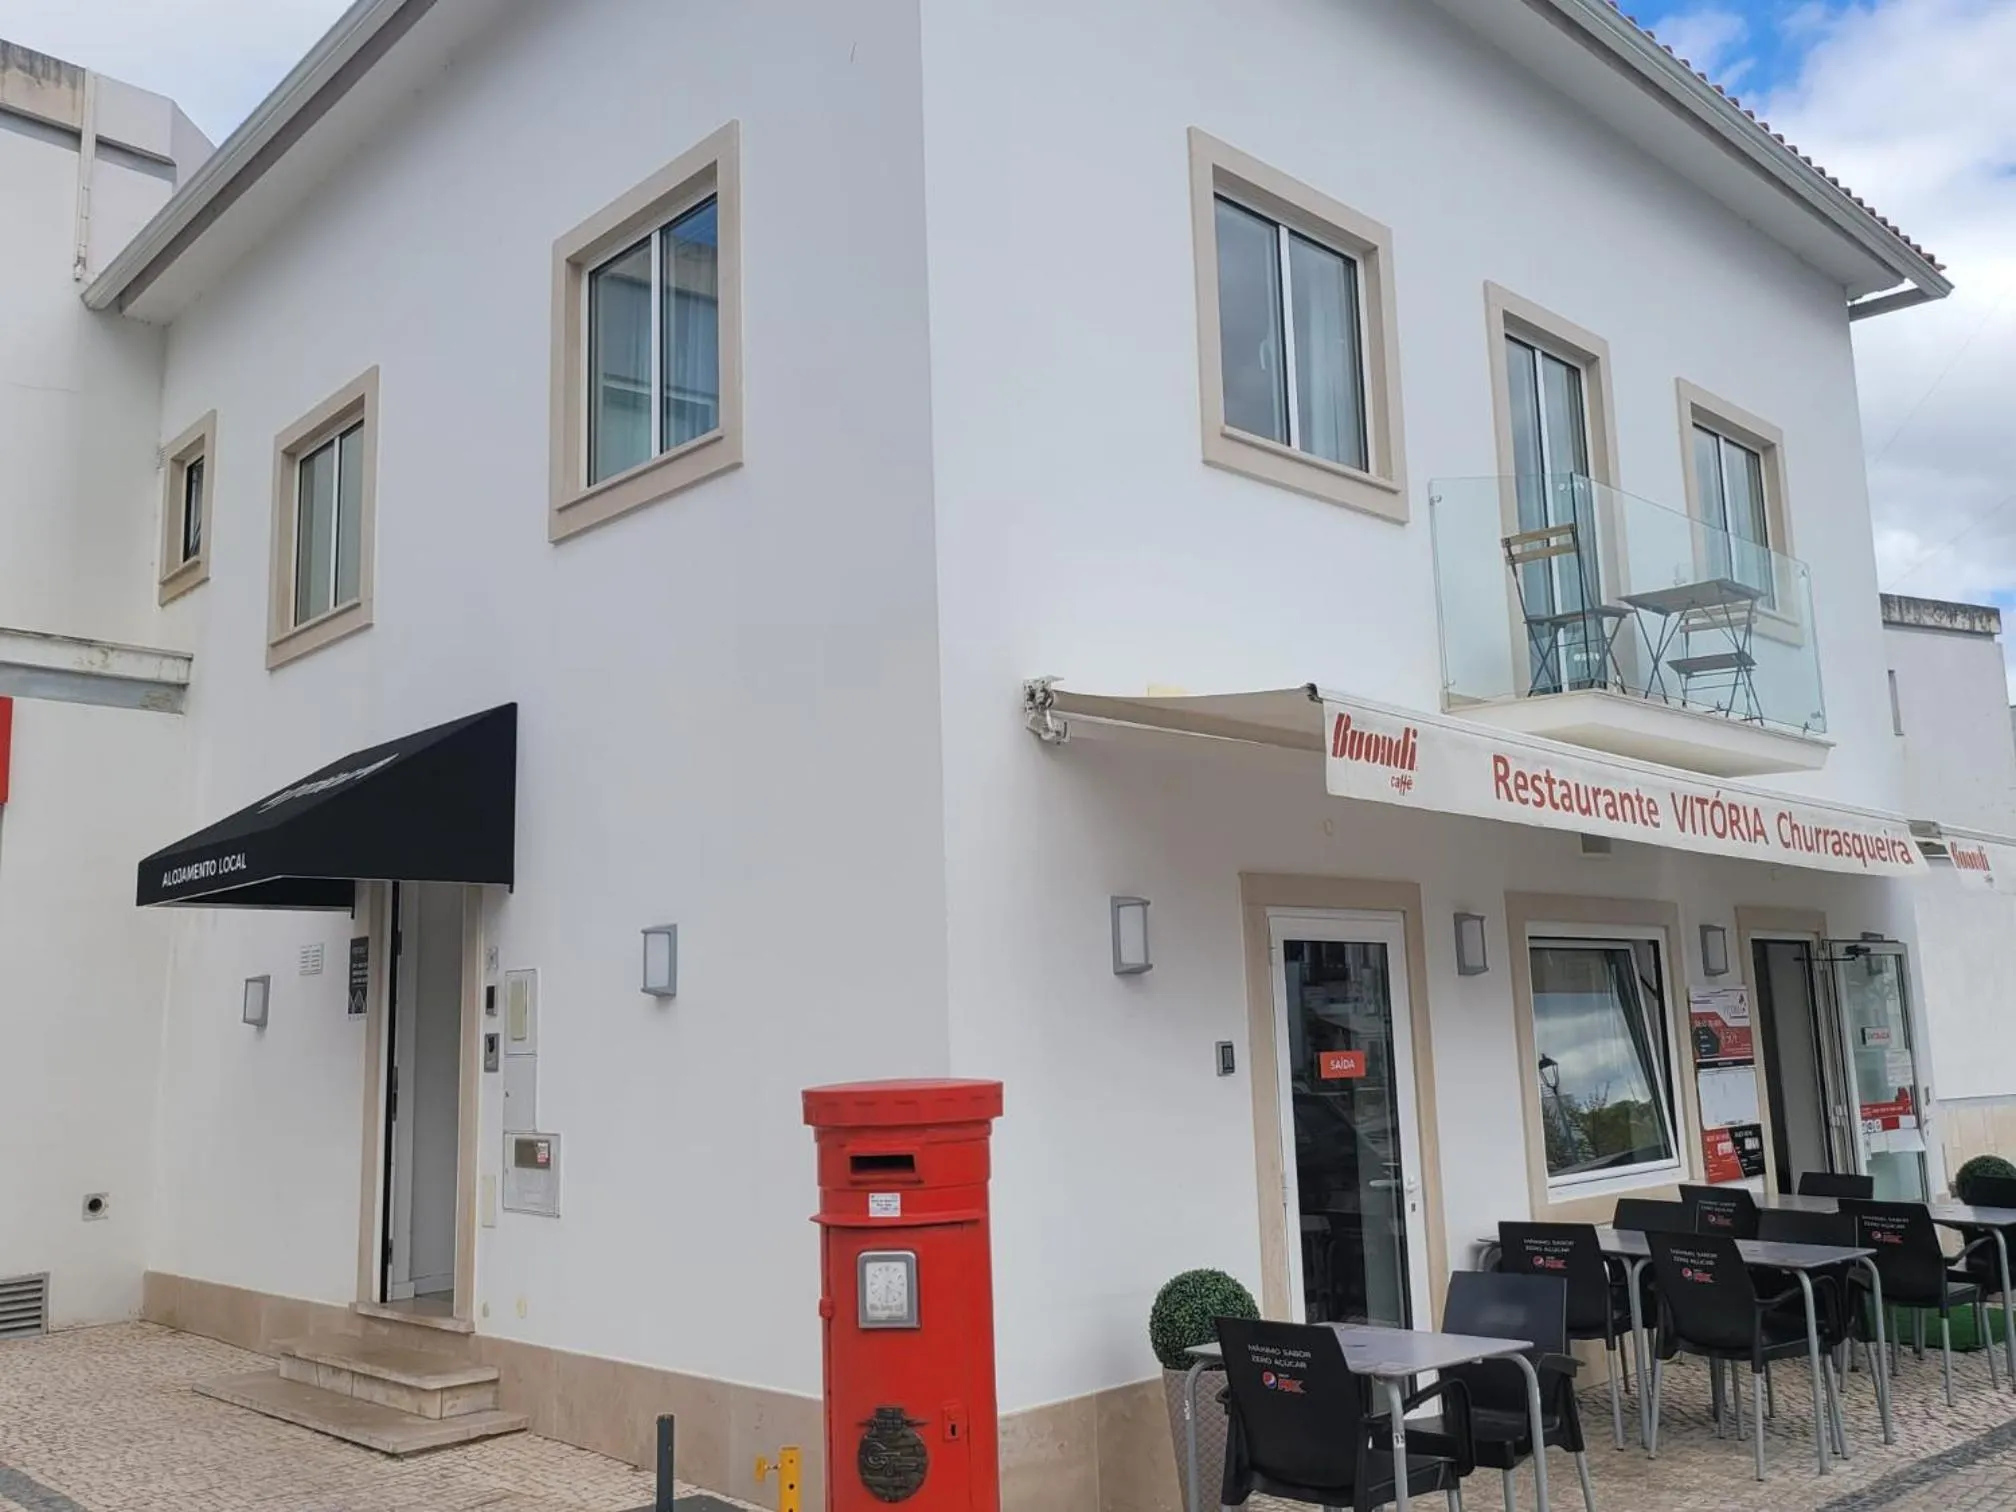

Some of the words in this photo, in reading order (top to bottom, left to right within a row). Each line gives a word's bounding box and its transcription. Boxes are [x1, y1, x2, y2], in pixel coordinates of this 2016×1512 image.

[1332, 712, 1417, 771] Buondi
[1492, 754, 1661, 829] Restaurante
[1671, 790, 1770, 846] VITÓRIA
[1777, 811, 1914, 868] Churrasqueira
[162, 859, 217, 888] ALOJAMENTO
[219, 852, 247, 874] LOCAL
[1329, 1056, 1356, 1070] SAÍDA
